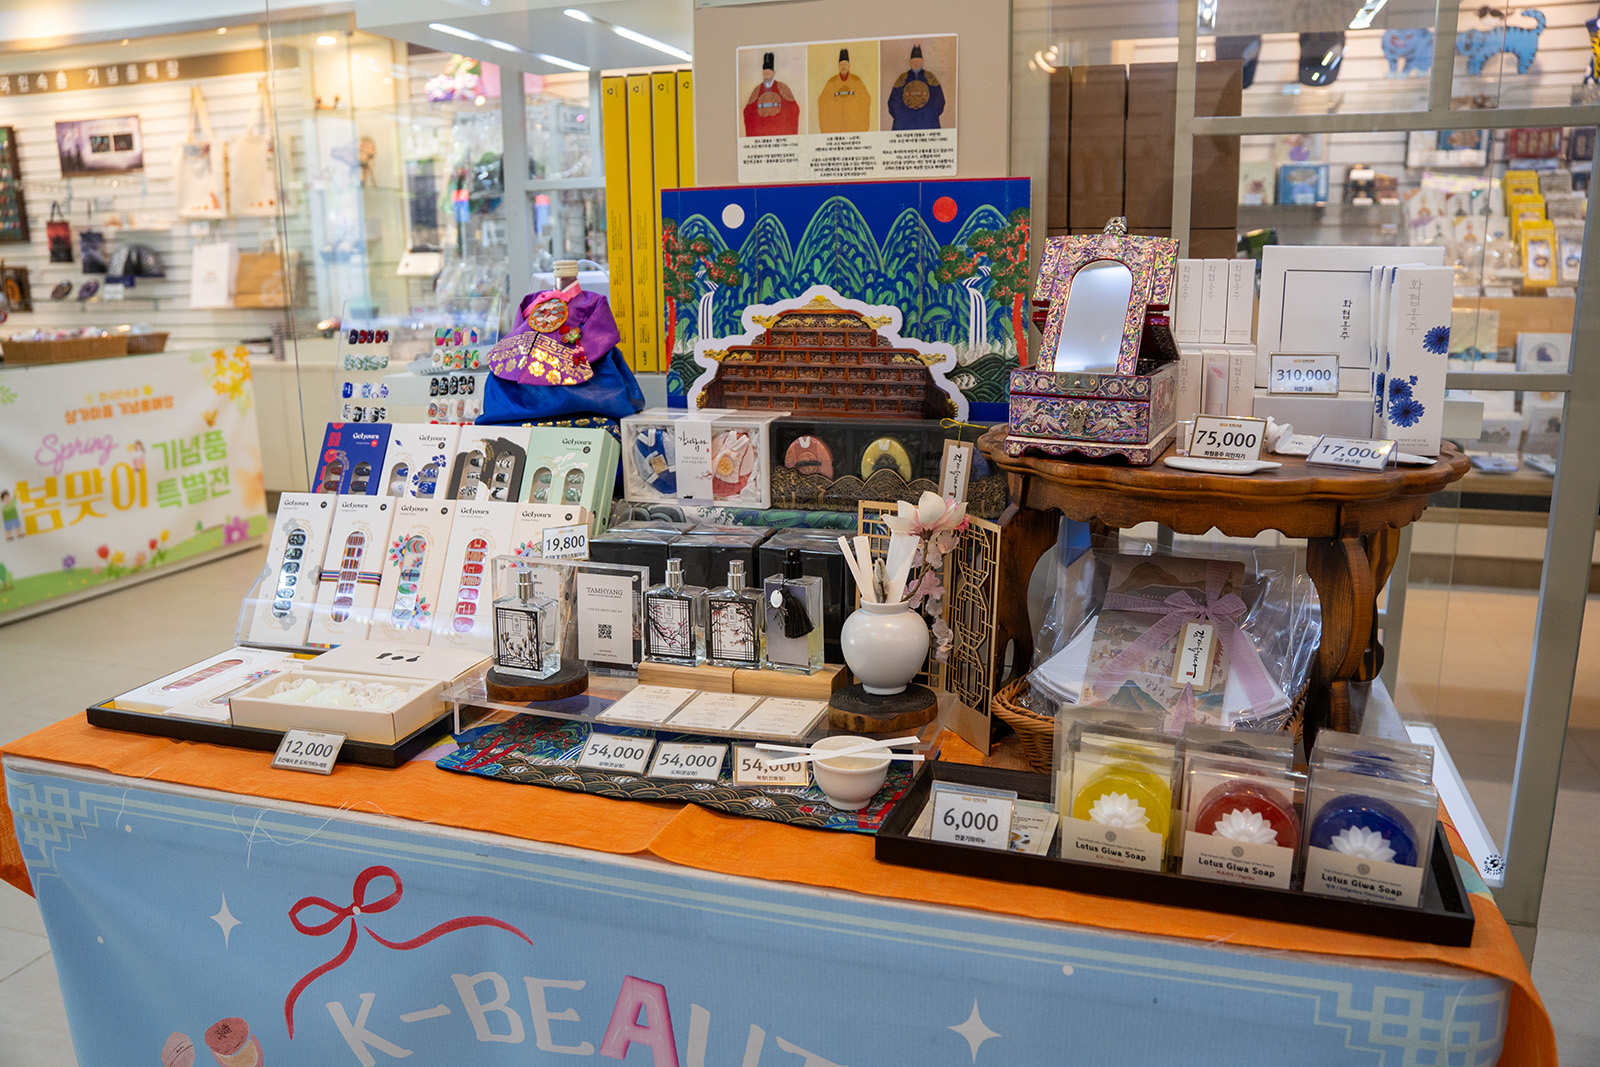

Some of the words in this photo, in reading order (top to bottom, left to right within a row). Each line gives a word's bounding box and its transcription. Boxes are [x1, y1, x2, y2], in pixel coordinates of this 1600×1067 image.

[1181, 265, 1191, 300] 화협옹주
[1207, 265, 1216, 300] 화협옹주
[1232, 265, 1243, 300] 화협옹주
[1406, 278, 1424, 335] 화협옹주
[1340, 299, 1353, 340] 화협옹주
[1233, 358, 1242, 394] 화협옹주
[1276, 369, 1332, 382] 310,000
[152, 429, 228, 471] 기념품
[1196, 430, 1256, 448] 75,000
[35, 434, 120, 475] Spring
[1322, 444, 1382, 459] 17,000
[156, 465, 231, 508] 특별전
[16, 462, 148, 536] 봄맞이
[546, 535, 585, 551] 19,800
[586, 587, 623, 595] TAMHYANG
[286, 740, 333, 757] 12,000
[588, 744, 644, 760] 54,000
[660, 754, 717, 768] 54,000
[944, 808, 998, 831] 6,000
[955, 834, 985, 844] 연꽃기와비누
[1076, 841, 1098, 852] Lotus
[1101, 847, 1122, 856] Giwa
[1125, 851, 1146, 862] Soap
[1199, 857, 1223, 868] Lotus
[1227, 862, 1249, 873] Giwa
[1252, 867, 1275, 878] Soap
[1322, 873, 1347, 884] Lotus
[1352, 880, 1375, 890] Giwa
[1379, 885, 1402, 897] Soap
